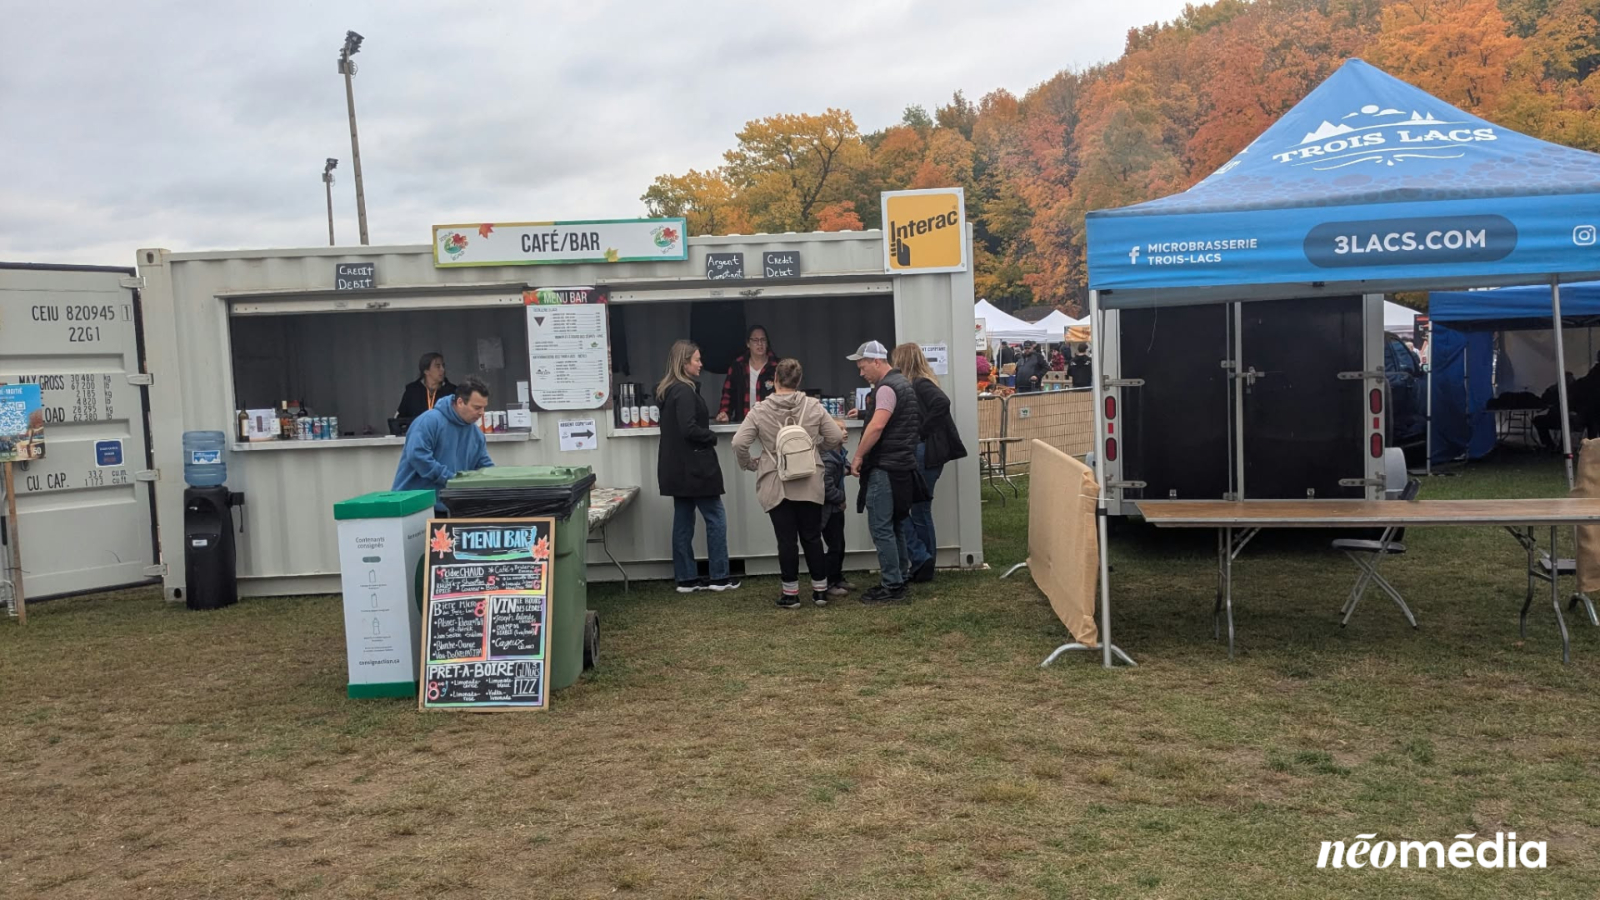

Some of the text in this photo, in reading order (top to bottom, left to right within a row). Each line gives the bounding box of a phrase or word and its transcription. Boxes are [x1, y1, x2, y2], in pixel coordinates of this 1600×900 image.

[1273, 128, 1498, 163] TROIS LACS
[890, 209, 958, 243] Interac
[521, 231, 601, 254] CAFÉ/BAR
[1148, 238, 1258, 254] MICROBRASSERIE
[1334, 229, 1487, 255] 3LACS.COM
[707, 254, 740, 270] Argent
[1147, 253, 1222, 266] TROIS-LACS
[543, 291, 588, 304] MENU BAR
[32, 305, 59, 321] CEIU
[66, 305, 116, 321] 820945
[69, 326, 101, 342] 22G1
[39, 374, 65, 391] GROSS
[27, 472, 70, 491] CU. CAP.
[461, 529, 529, 550] MENU BAR
[459, 566, 485, 577] CHAUD
[474, 601, 486, 618] 8
[493, 597, 517, 614] VIN
[514, 678, 538, 695] FIZZ
